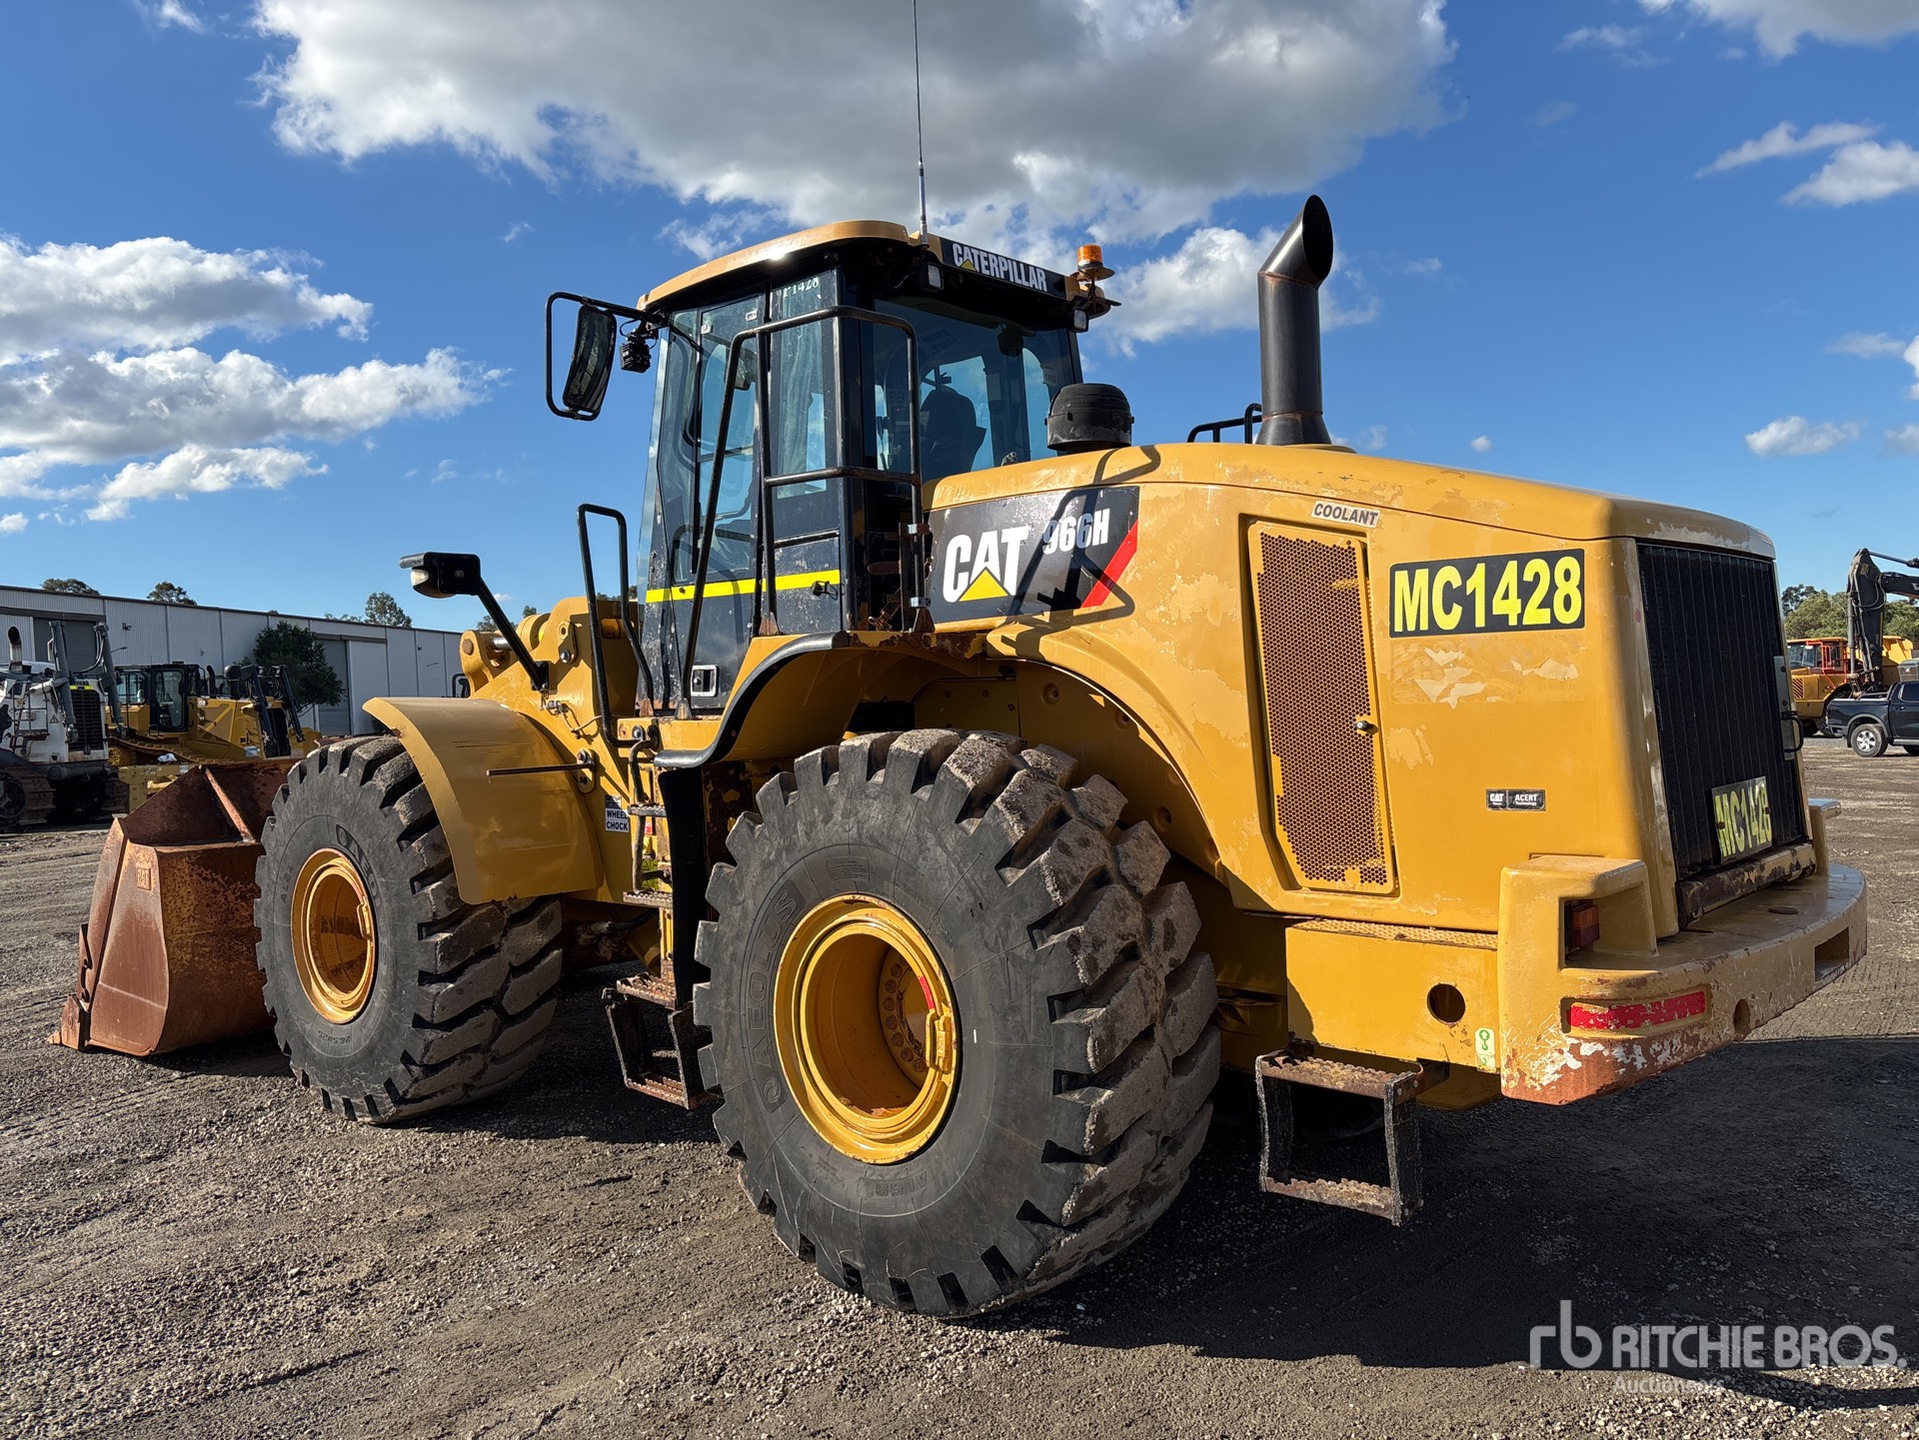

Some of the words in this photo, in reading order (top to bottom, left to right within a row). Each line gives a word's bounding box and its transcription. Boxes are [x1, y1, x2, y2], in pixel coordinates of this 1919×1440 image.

[952, 242, 1048, 292] CATERPILLAR
[1314, 503, 1379, 526] COOLANT
[942, 526, 1029, 603] CAT
[1042, 508, 1111, 555] 966H
[1394, 556, 1582, 633] MC1428
[1490, 793, 1504, 802] CAT
[1515, 793, 1538, 802] ACERT
[606, 809, 628, 819] WHEEL
[606, 820, 628, 831] CHOCK
[749, 888, 797, 1068] AEOLUS
